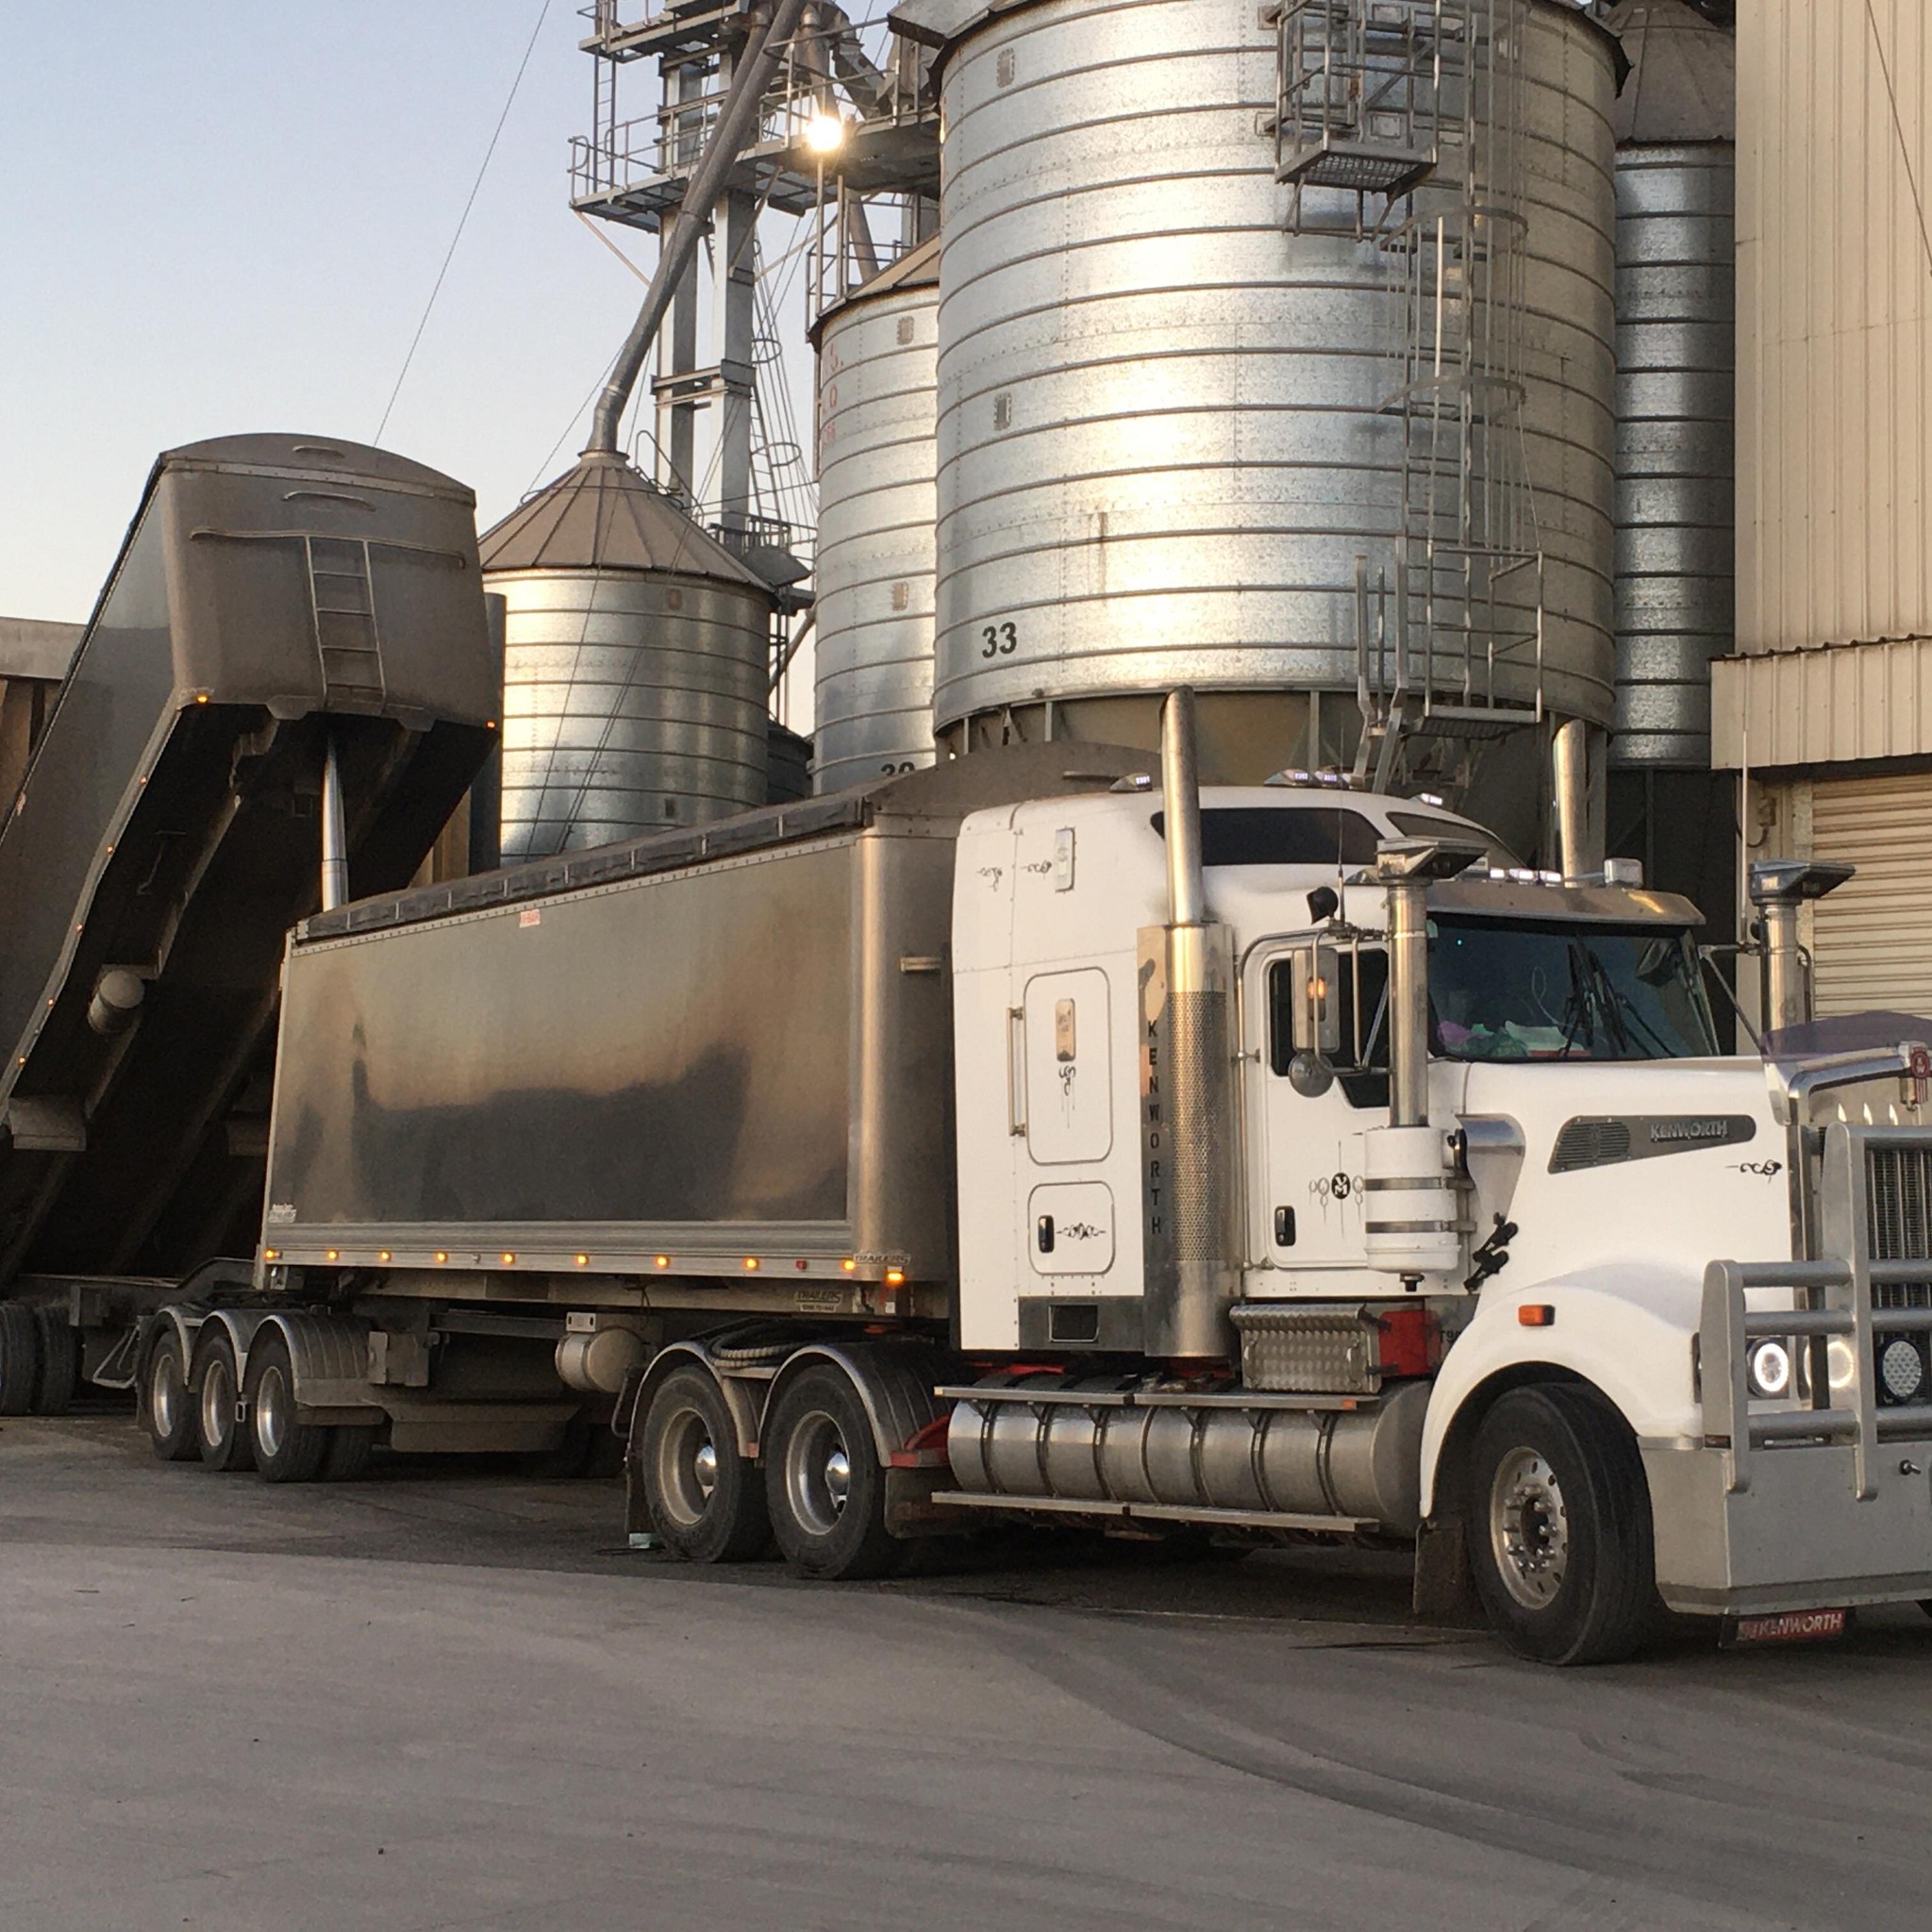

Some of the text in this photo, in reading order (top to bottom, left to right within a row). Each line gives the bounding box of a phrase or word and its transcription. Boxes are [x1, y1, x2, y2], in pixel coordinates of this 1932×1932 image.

[981, 622, 1017, 658] 33
[1148, 1021, 1161, 1234] KENWORTH
[1650, 1120, 1727, 1140] KENWORTH
[1758, 1612, 1842, 1636] KENWORTH
